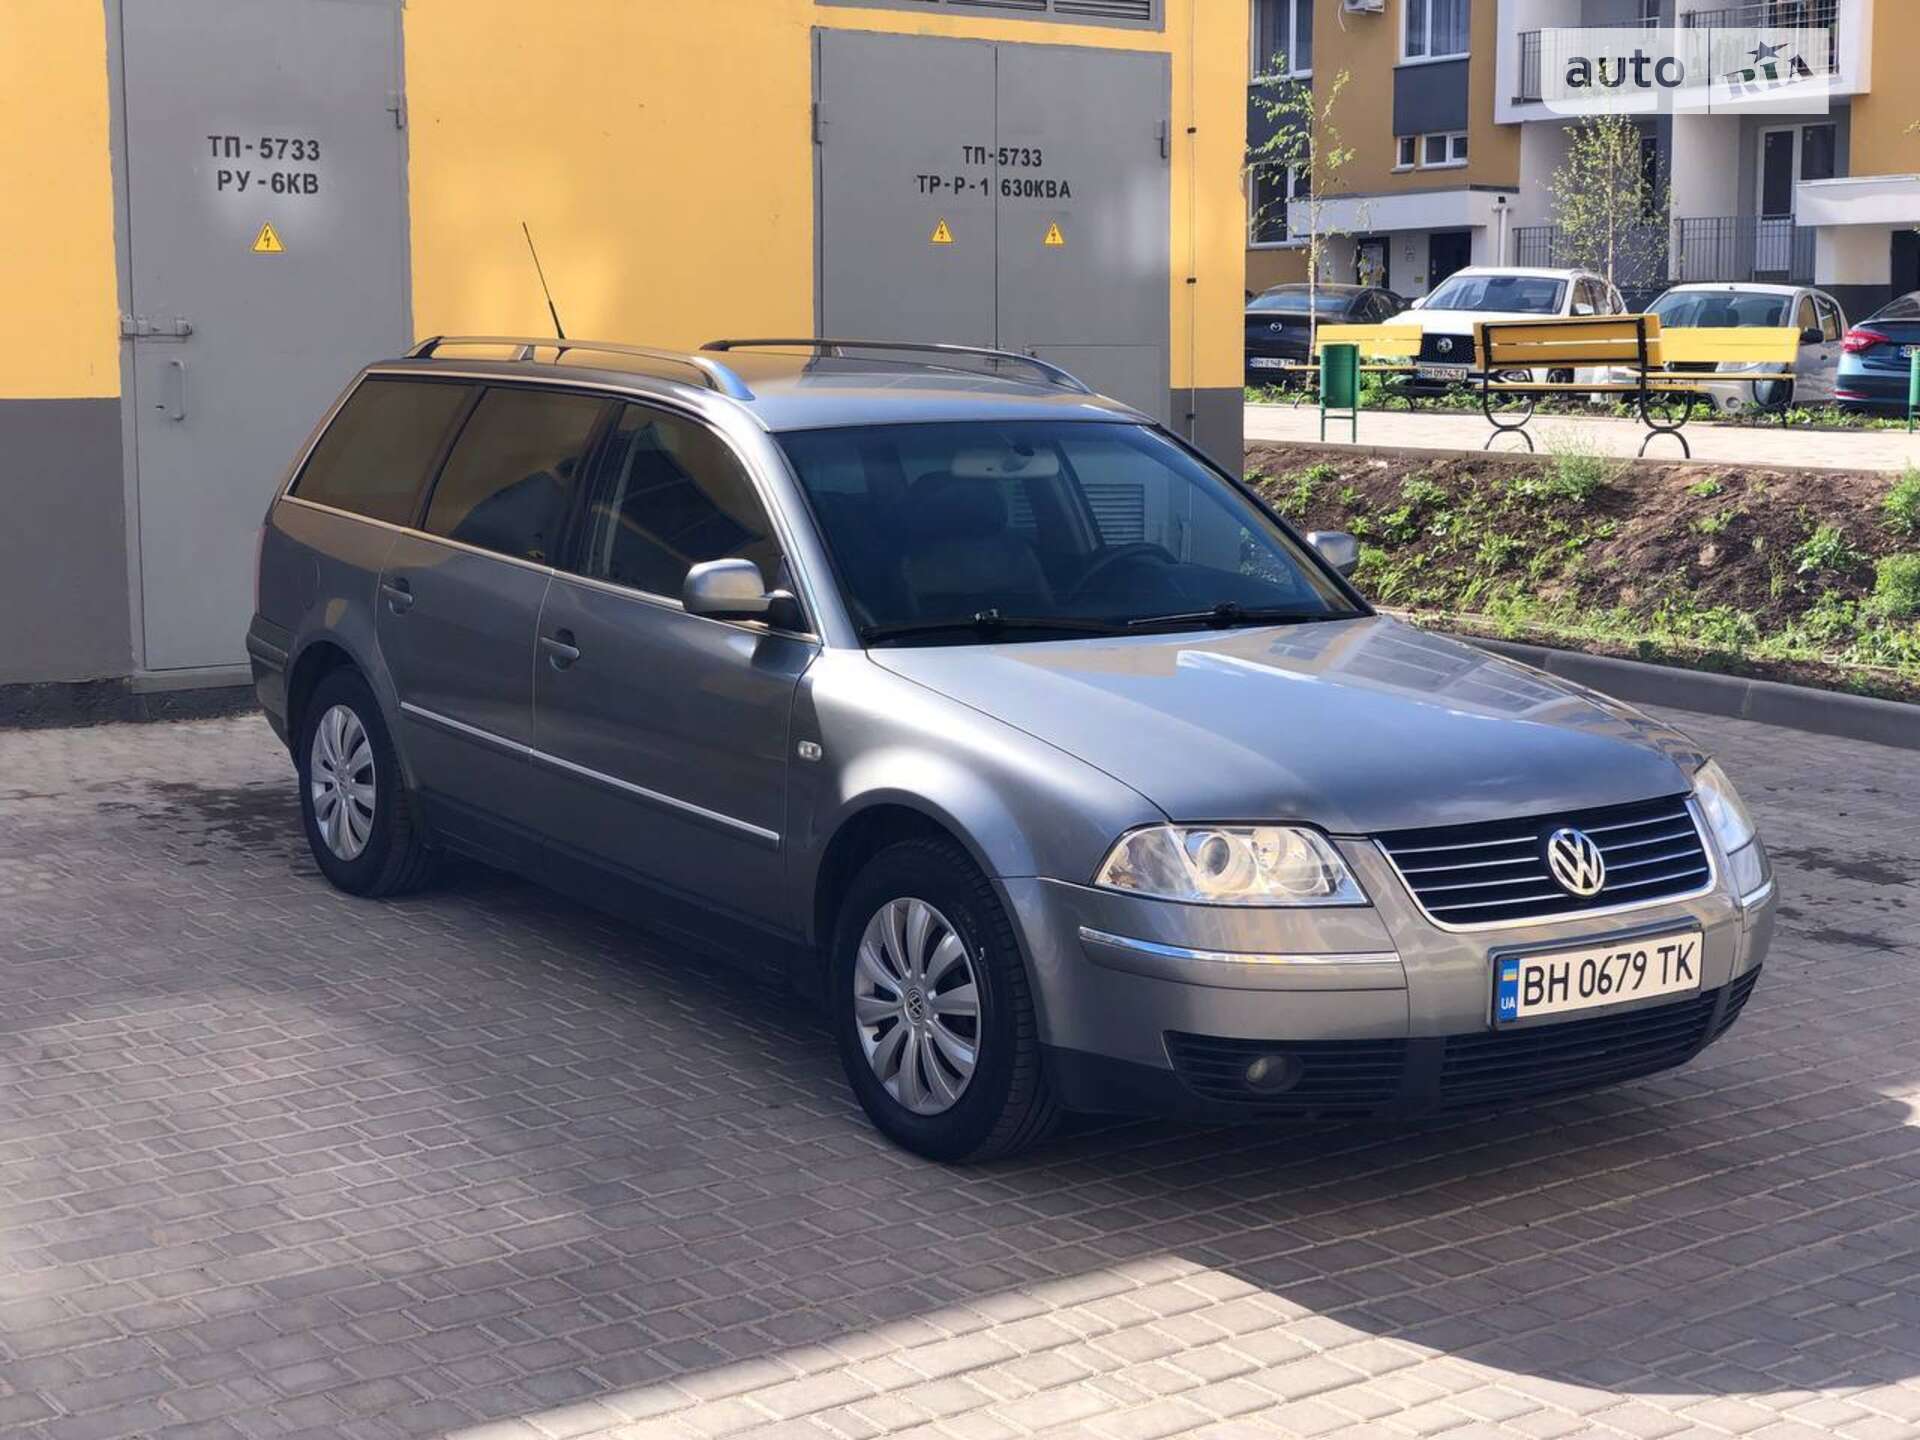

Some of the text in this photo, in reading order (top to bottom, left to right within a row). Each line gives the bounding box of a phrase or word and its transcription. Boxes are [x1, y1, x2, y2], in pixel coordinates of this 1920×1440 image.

[1523, 941, 1696, 1006] BH 0679 TK
[1500, 997, 1516, 1010] UA
